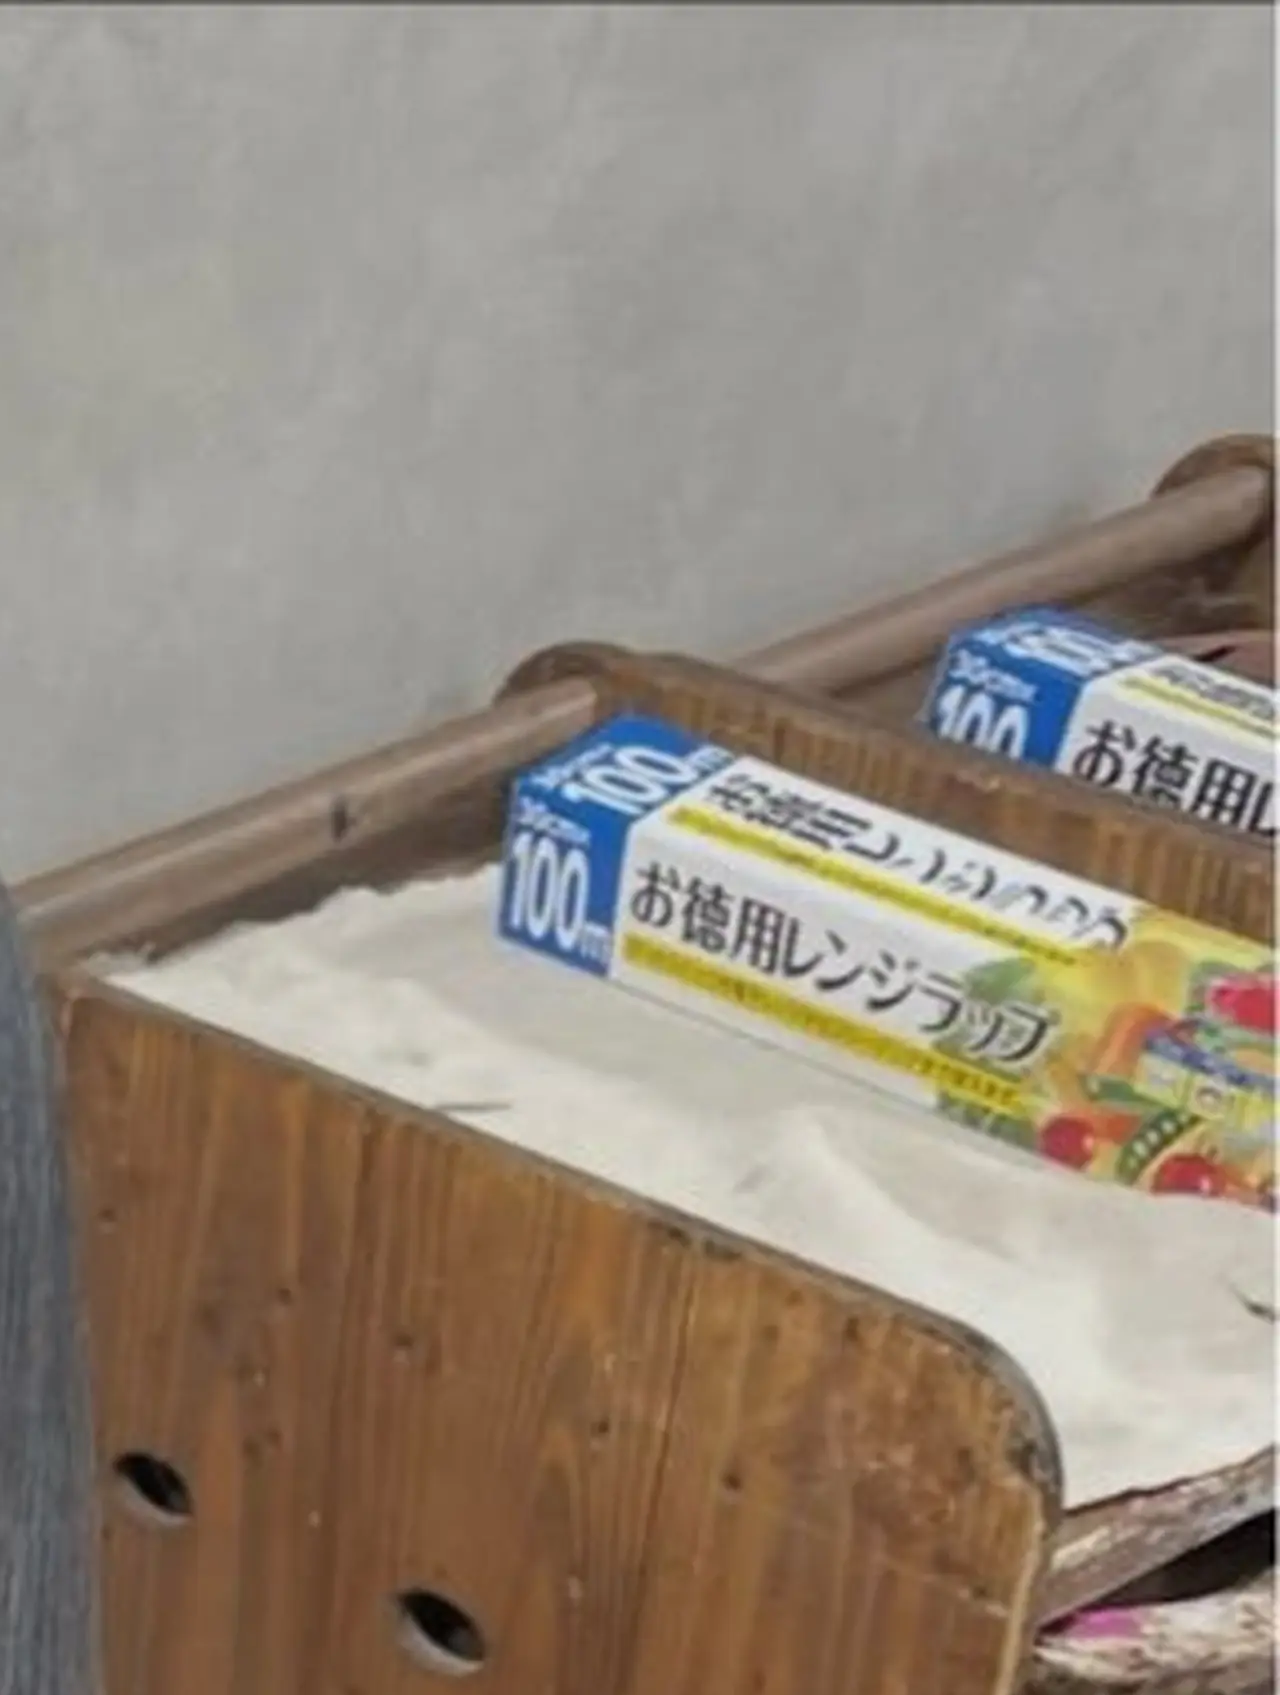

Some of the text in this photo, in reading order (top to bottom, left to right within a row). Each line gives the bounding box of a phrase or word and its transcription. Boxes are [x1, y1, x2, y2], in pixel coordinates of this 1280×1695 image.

[629, 862, 1061, 1062] お徳用レンジラップ
